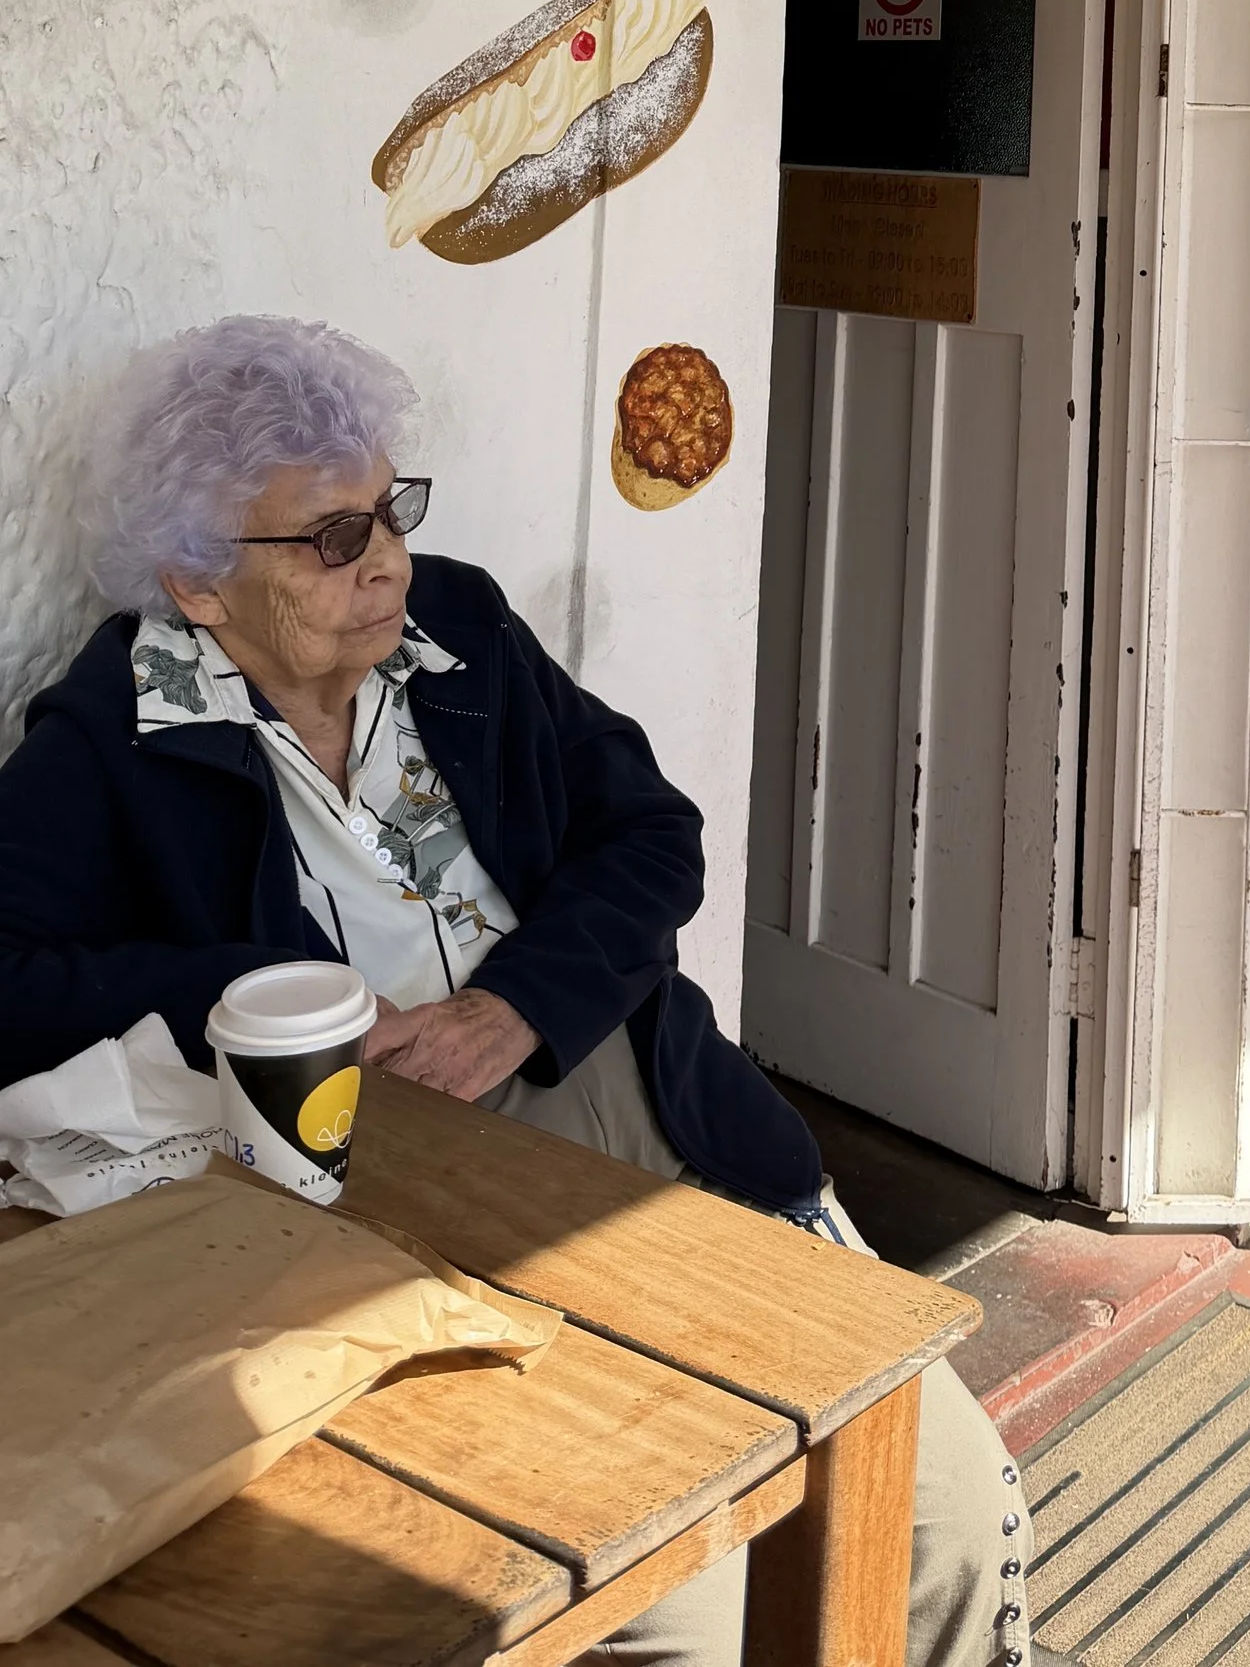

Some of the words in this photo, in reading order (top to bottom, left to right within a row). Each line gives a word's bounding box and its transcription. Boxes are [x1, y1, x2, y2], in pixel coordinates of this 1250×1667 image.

[865, 17, 888, 36] NO
[893, 17, 933, 36] PETS
[299, 1158, 348, 1188] kleine
